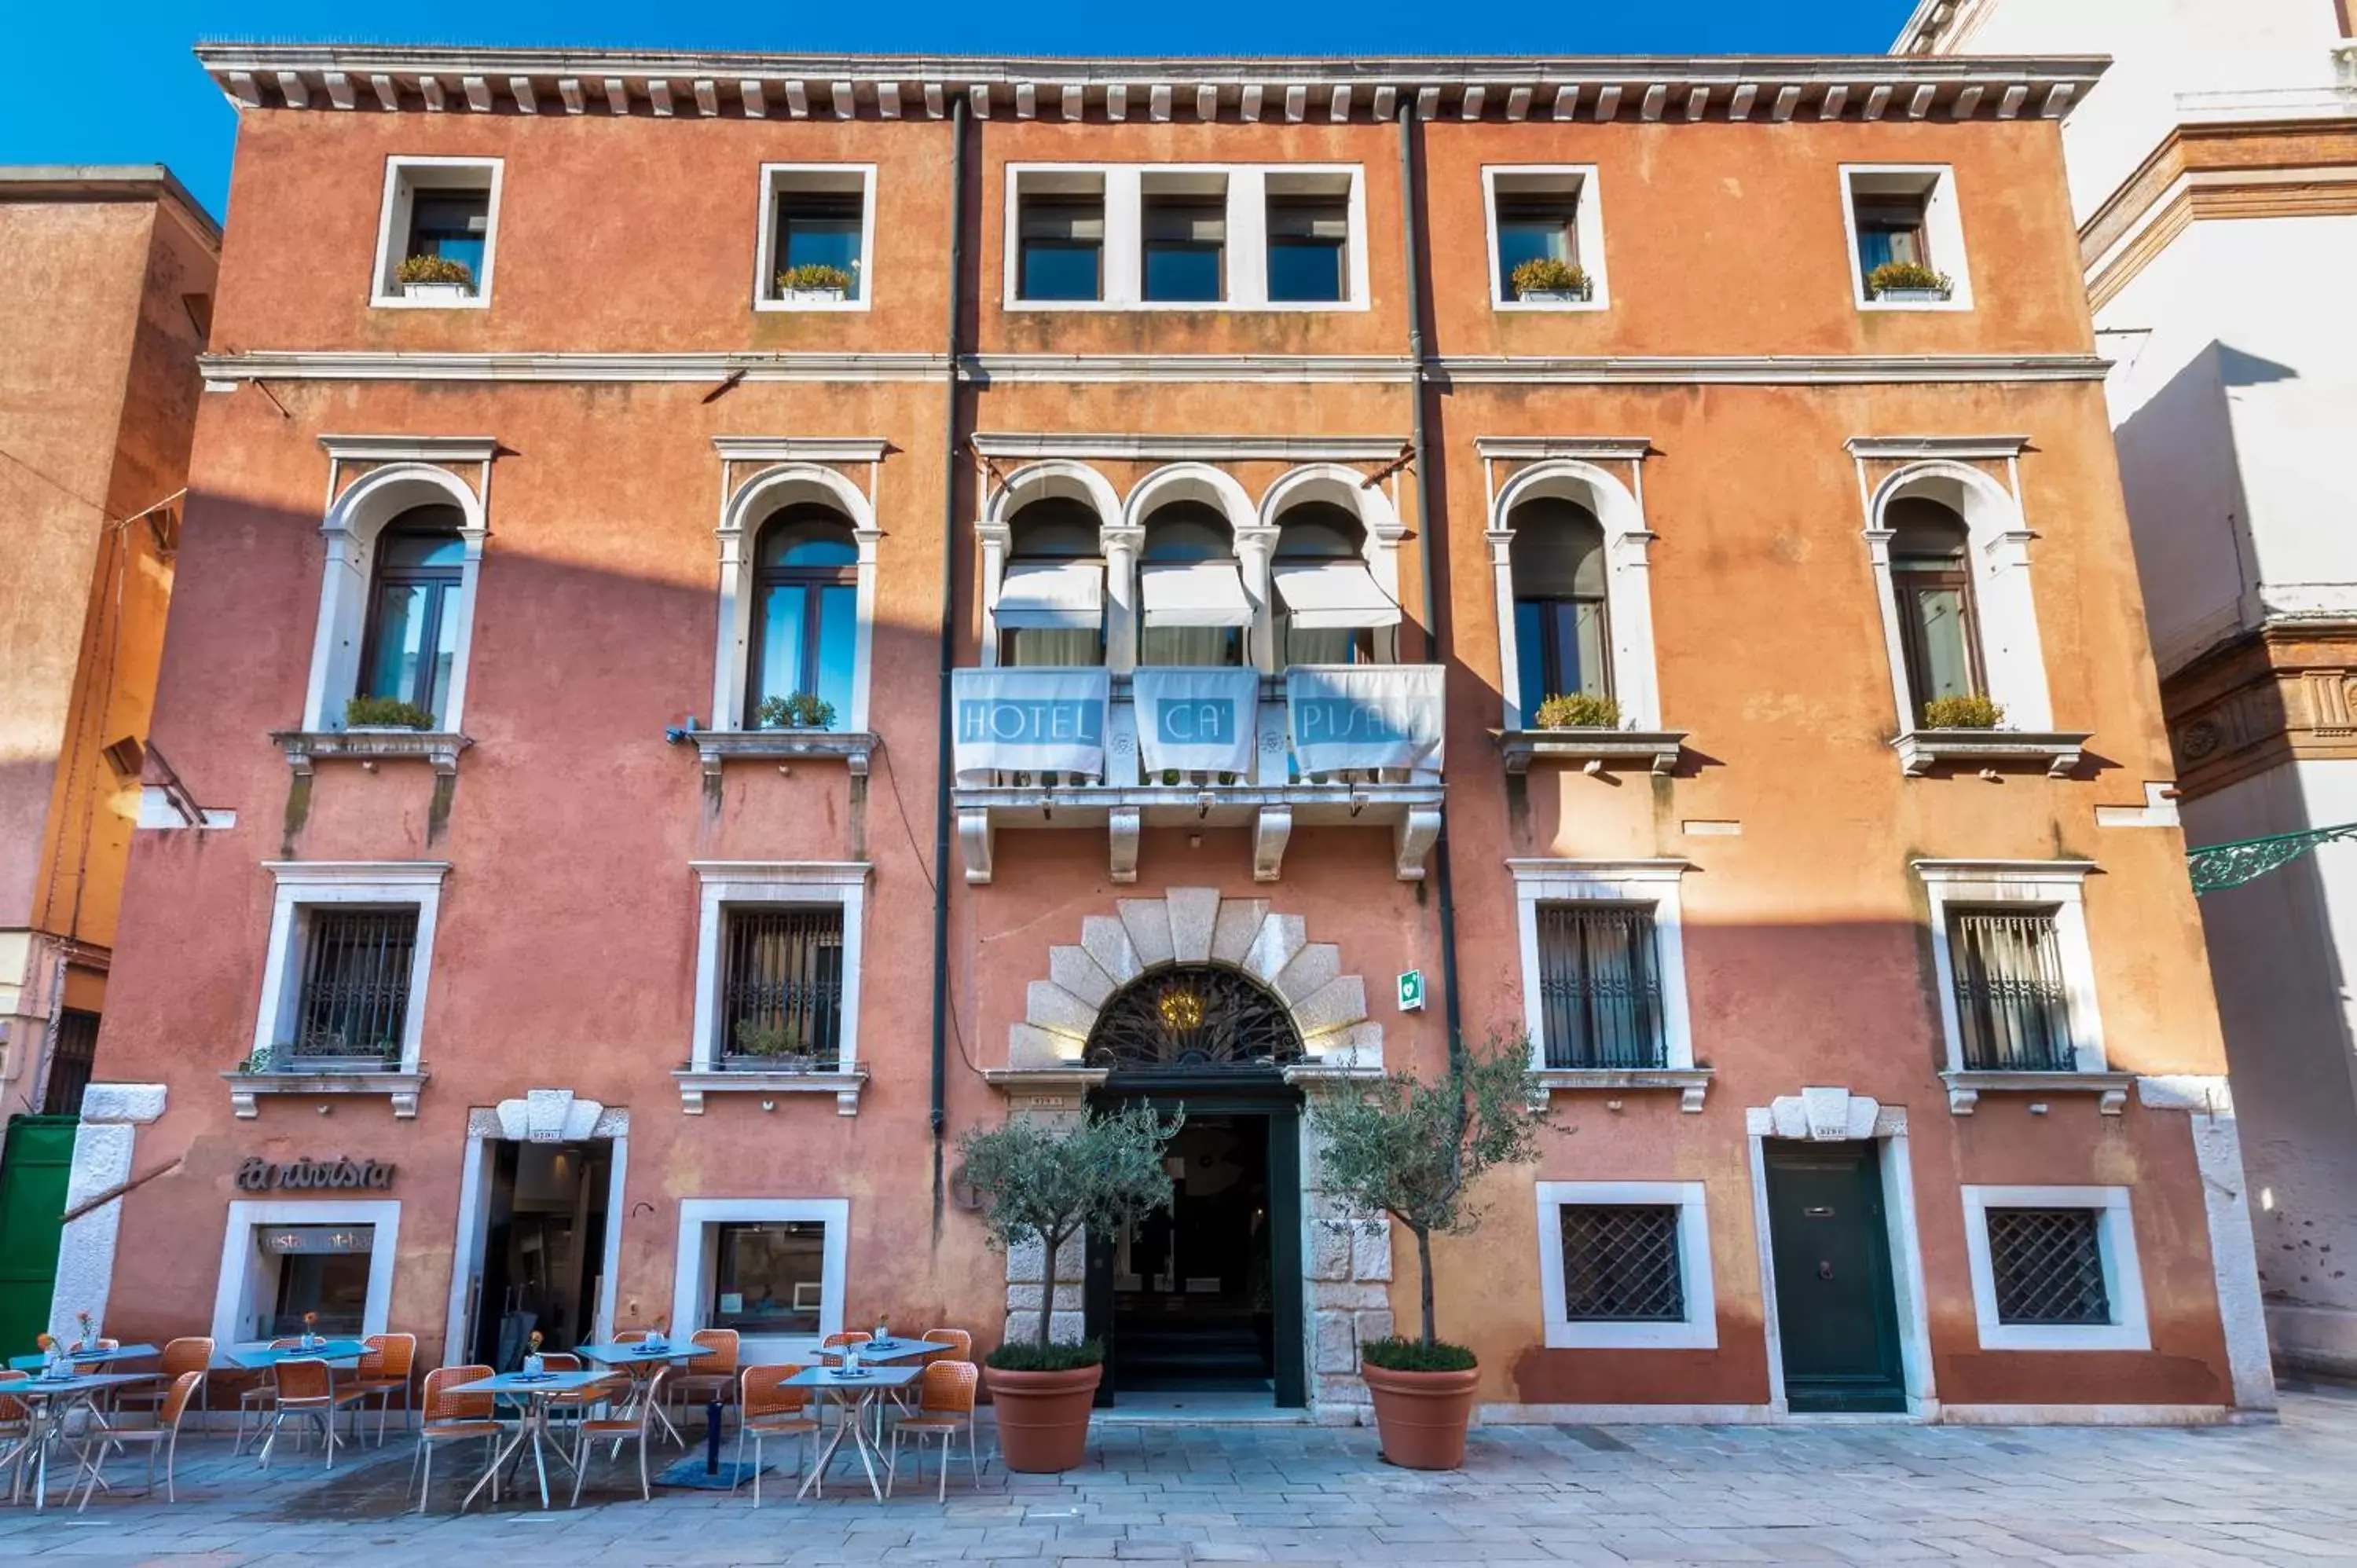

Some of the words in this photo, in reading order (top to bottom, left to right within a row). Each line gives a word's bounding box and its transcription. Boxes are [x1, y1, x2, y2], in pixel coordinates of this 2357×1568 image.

[966, 704, 1094, 739] HOTEL
[1165, 704, 1225, 739] CA'
[266, 1231, 373, 1249] restaunt-bar
